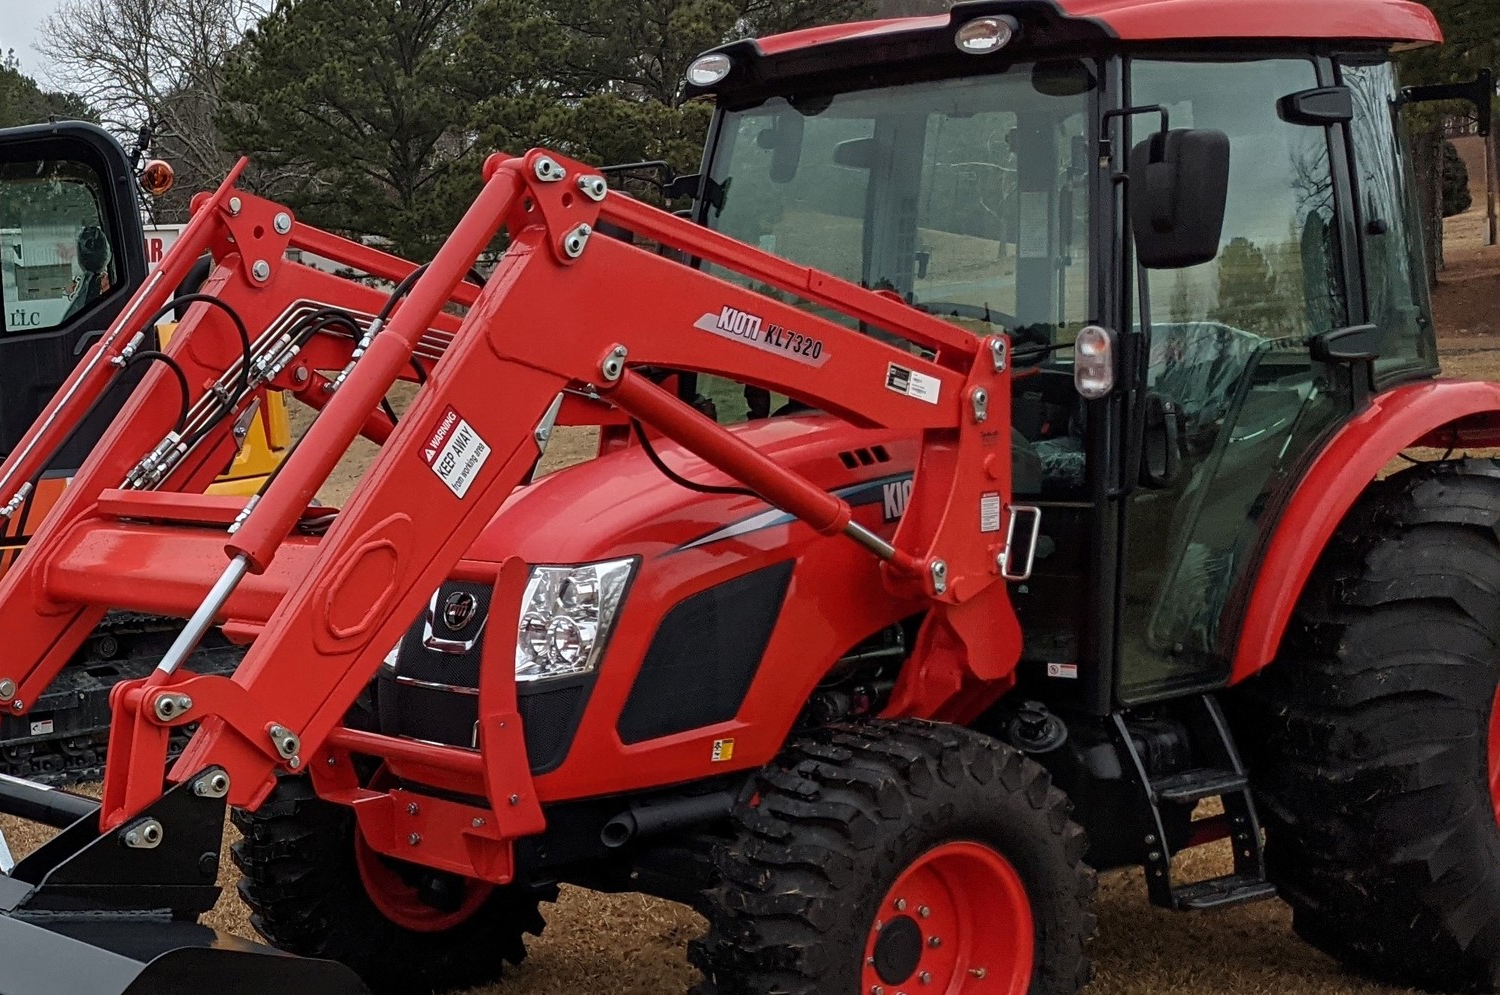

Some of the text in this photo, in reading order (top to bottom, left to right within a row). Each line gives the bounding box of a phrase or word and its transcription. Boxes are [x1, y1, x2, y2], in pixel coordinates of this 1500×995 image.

[10, 311, 41, 327] LLC
[716, 305, 823, 359] KIOTI KL7320
[429, 411, 457, 449] WARNING
[437, 426, 473, 480] KEEP AWAY
[451, 442, 486, 491] from working area
[883, 480, 913, 519] KIO
